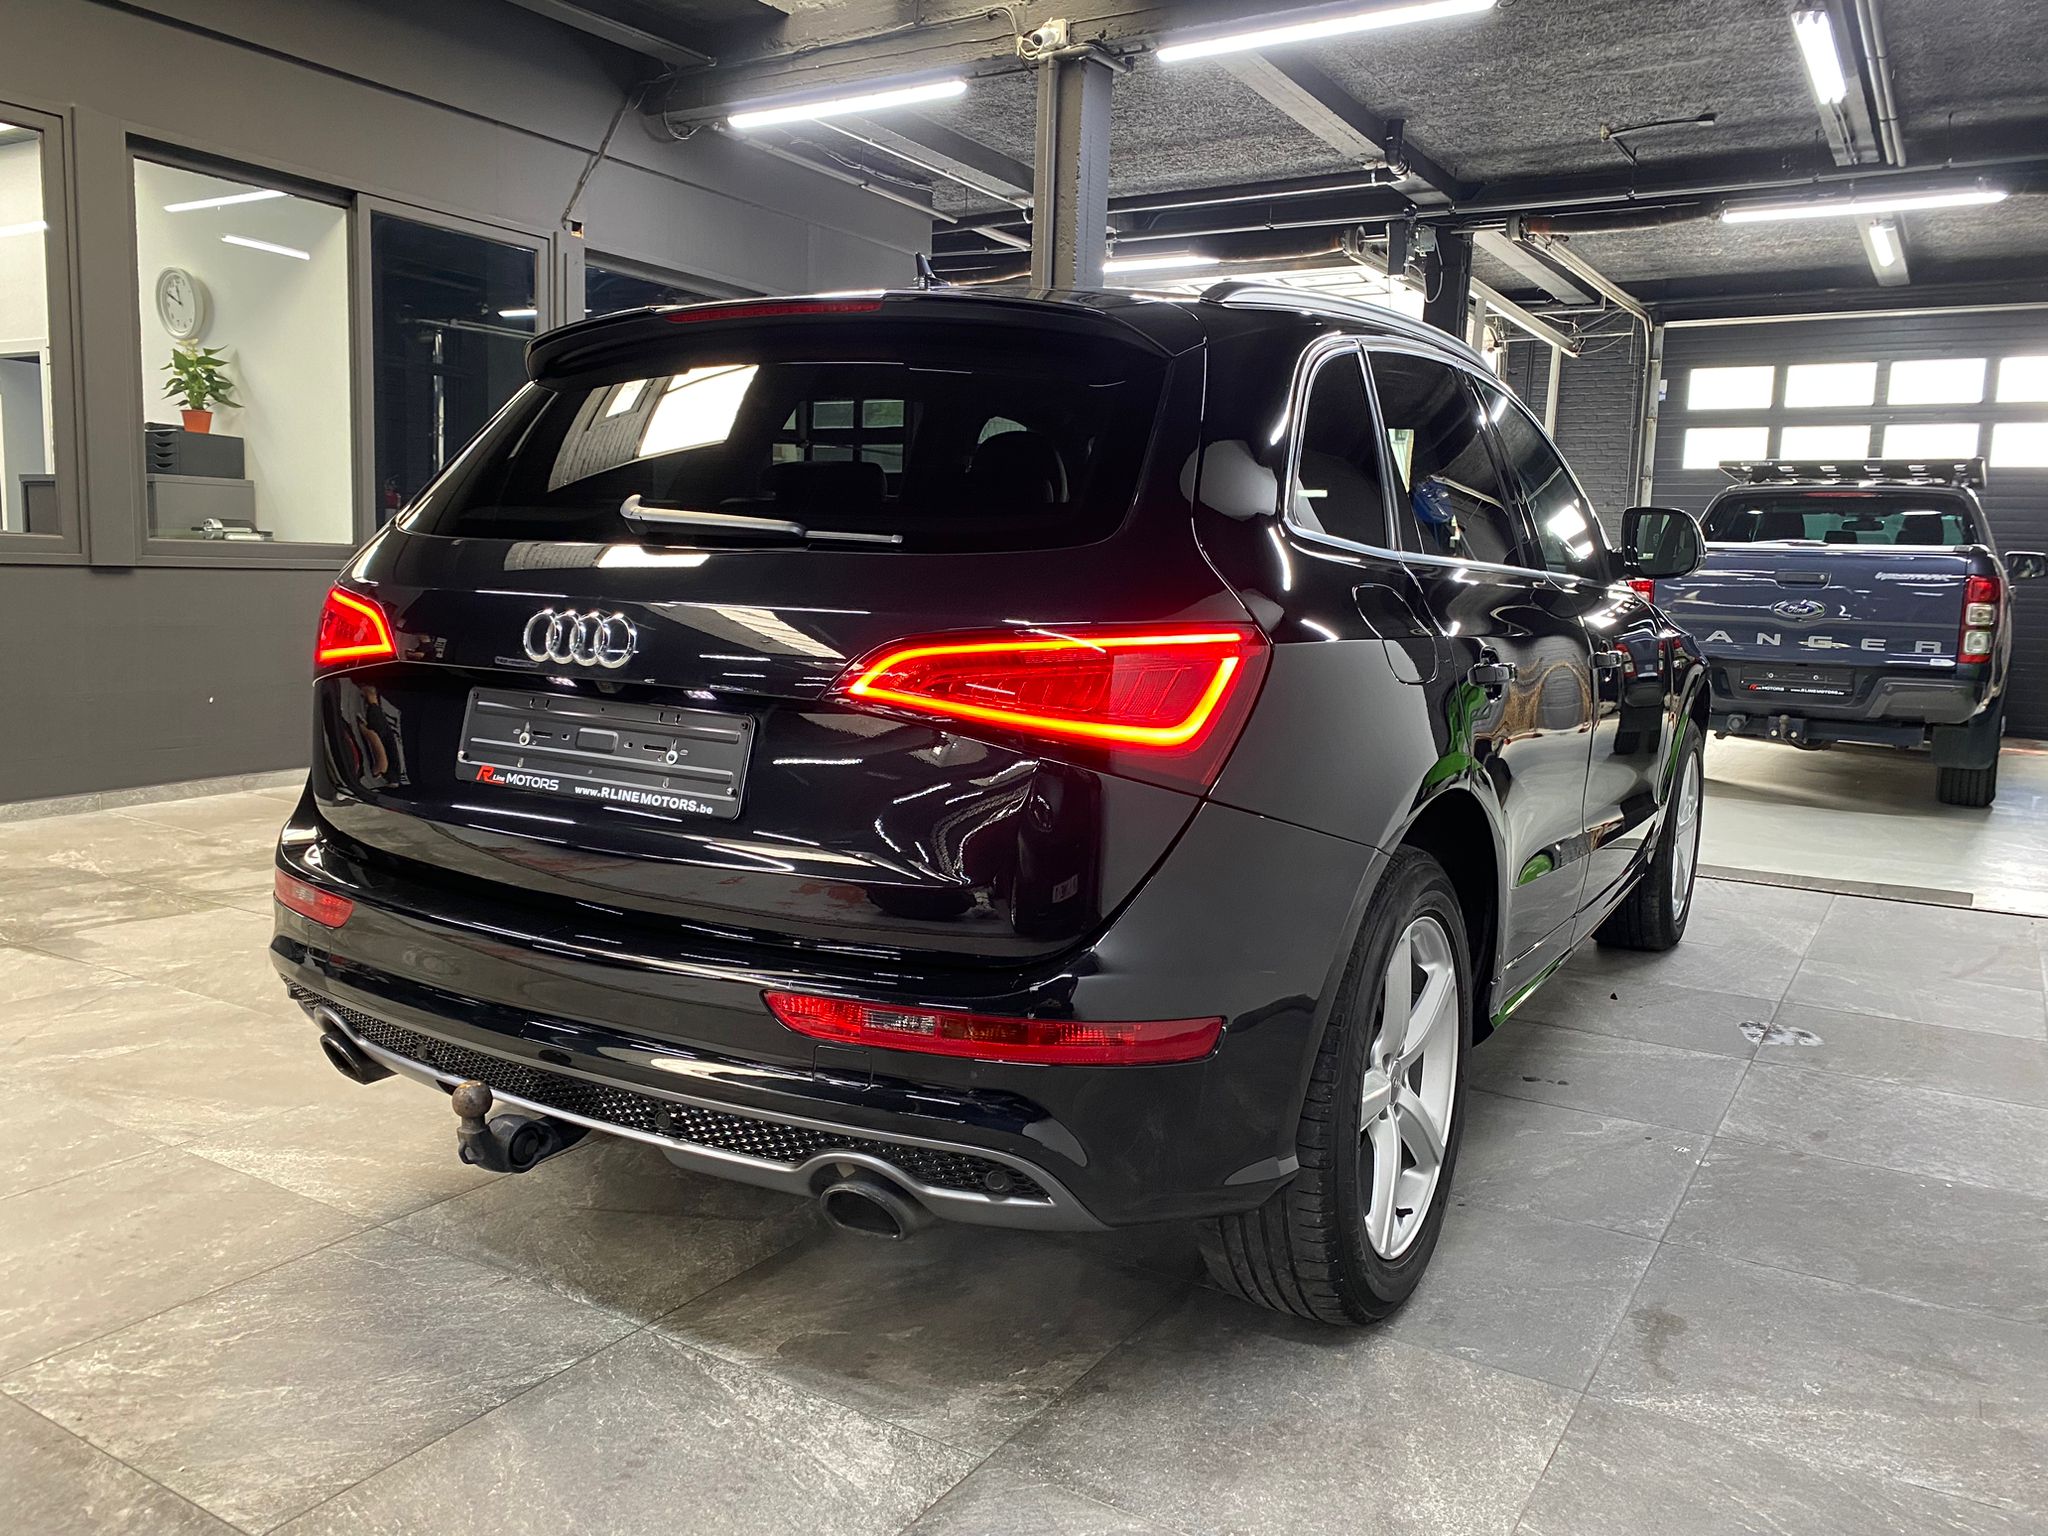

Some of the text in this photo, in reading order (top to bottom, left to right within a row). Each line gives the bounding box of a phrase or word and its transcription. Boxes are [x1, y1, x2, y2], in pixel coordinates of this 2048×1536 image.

[1788, 604, 1809, 613] Ford
[1705, 630, 1942, 653] ANGER
[506, 772, 560, 791] MOTORS
[574, 785, 714, 815] www.RLINEMOTORS.be
